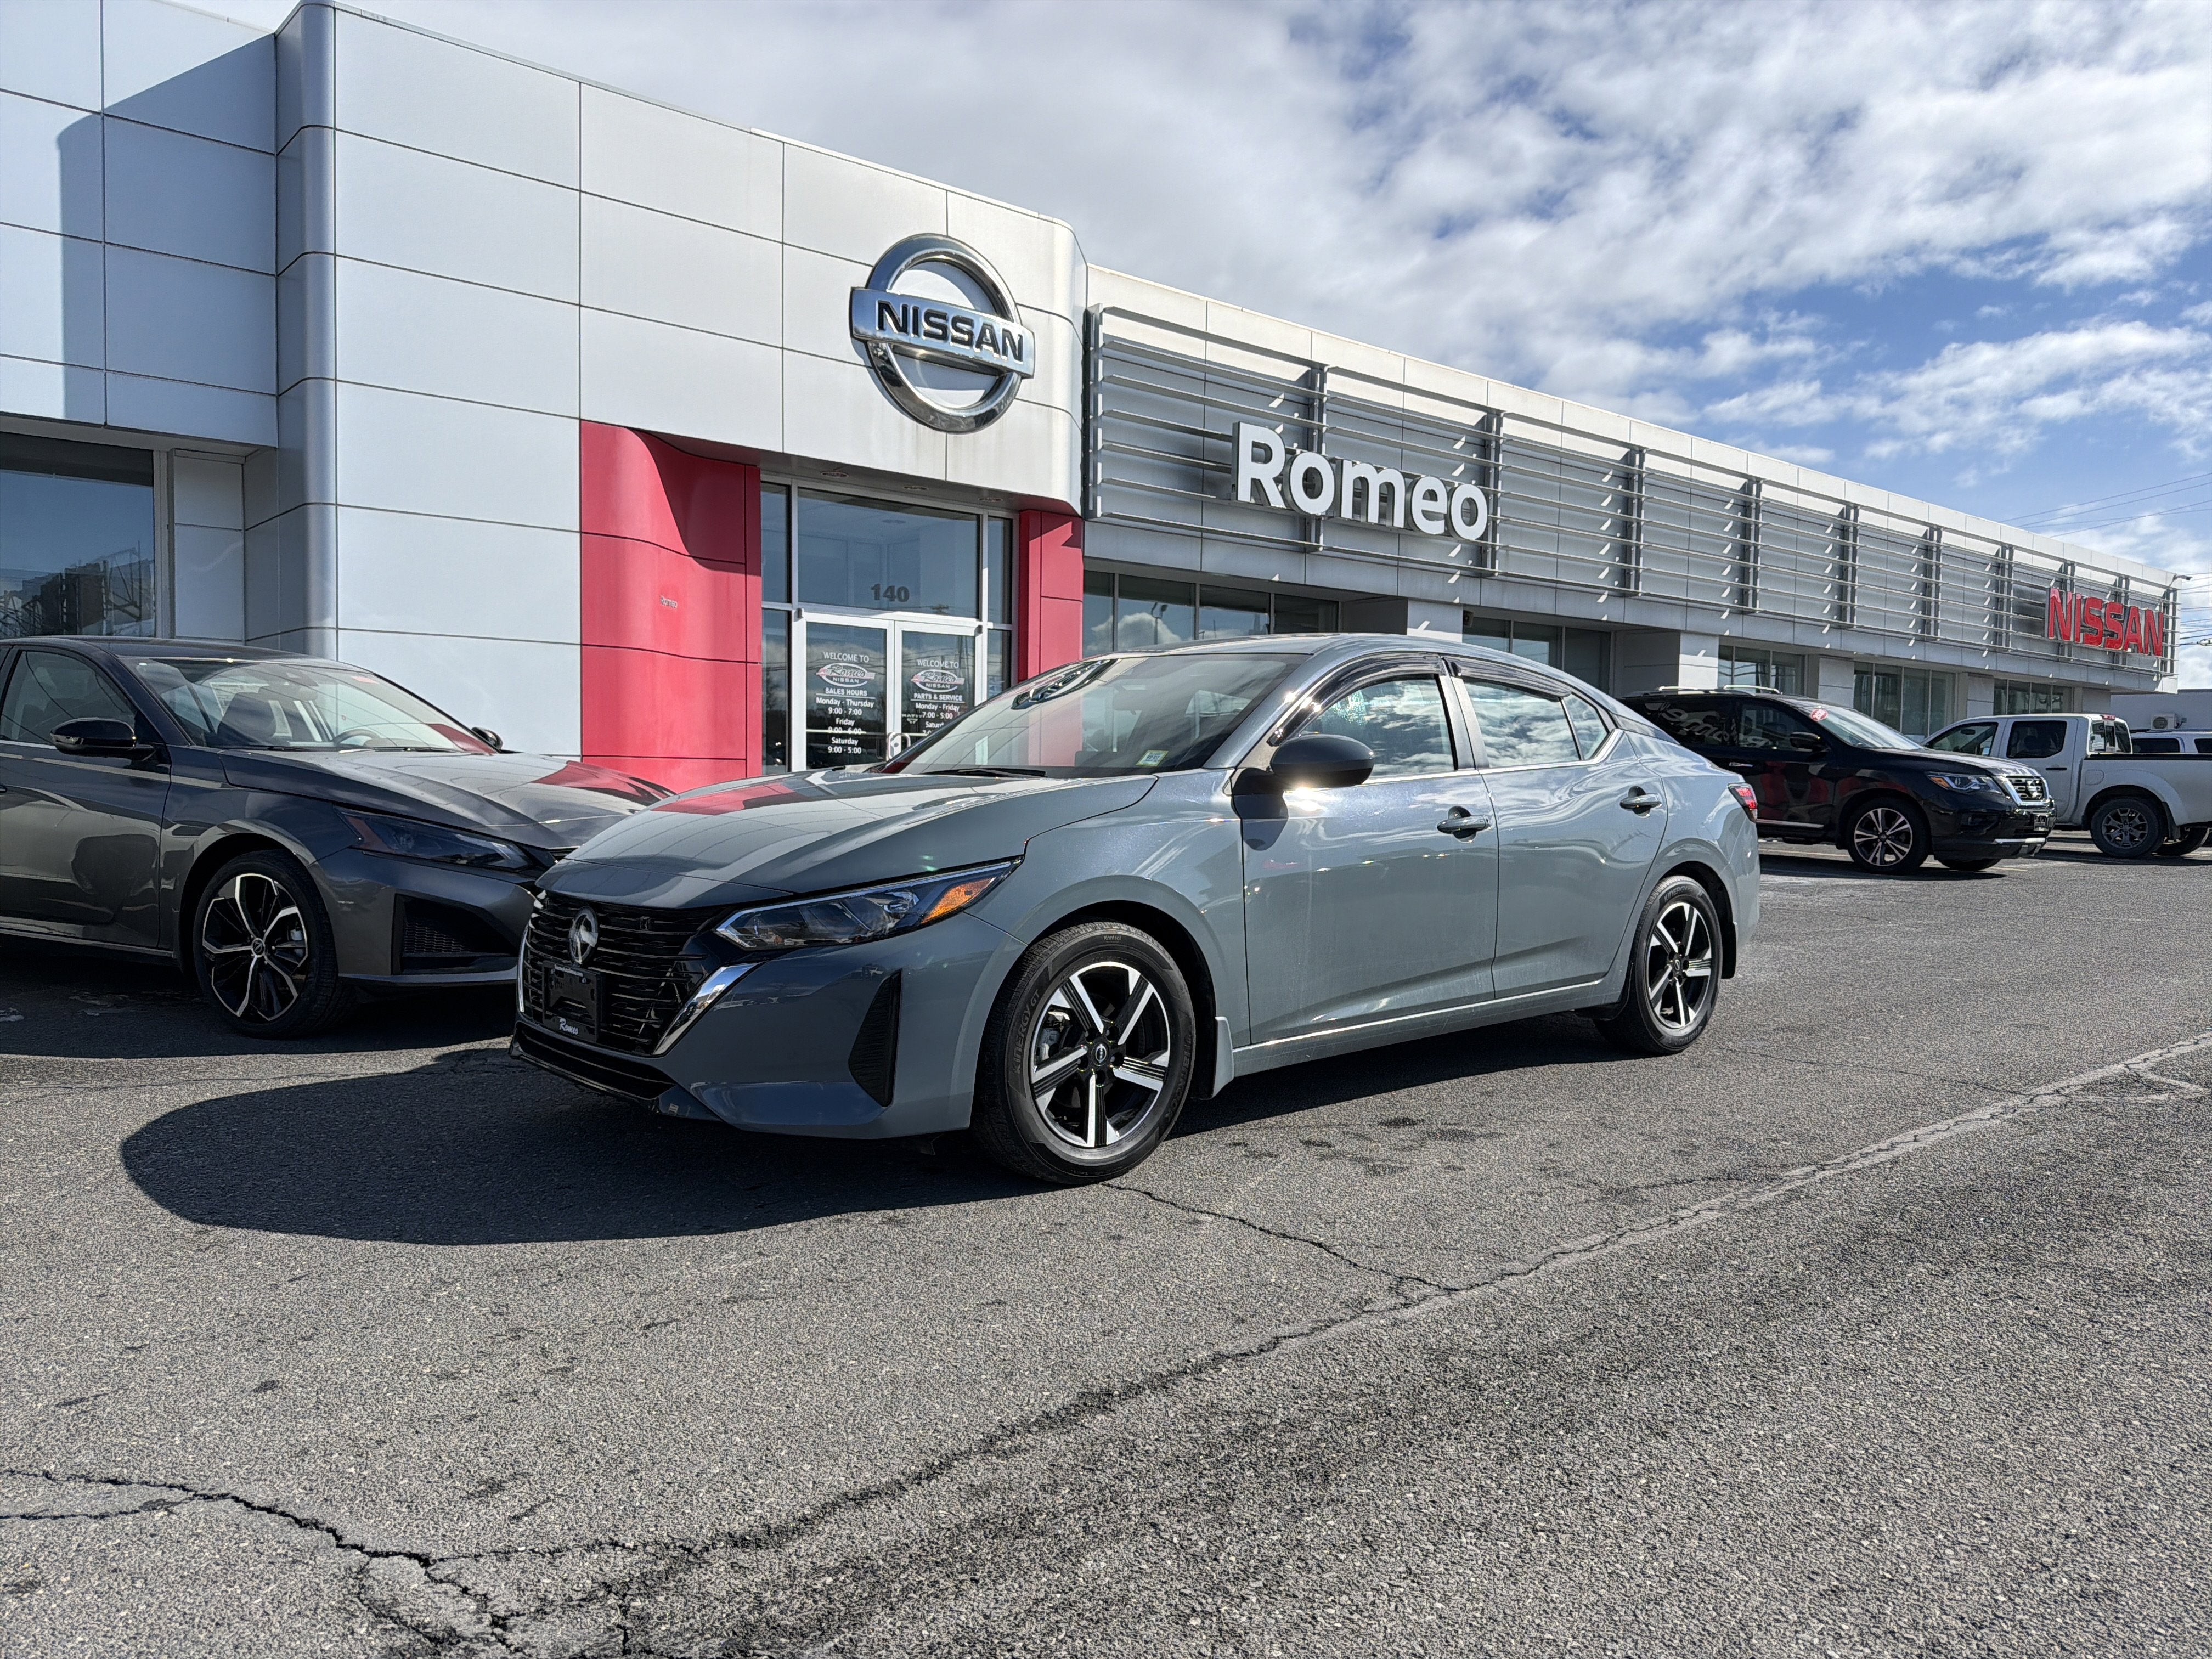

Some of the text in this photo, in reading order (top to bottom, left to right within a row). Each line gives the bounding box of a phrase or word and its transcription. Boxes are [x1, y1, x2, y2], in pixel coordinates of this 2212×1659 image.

[876, 301, 1024, 364] NISSAN
[1232, 421, 1487, 541] Romeo
[871, 584, 910, 602] 140
[2045, 588, 2164, 657] NISSAN
[823, 652, 870, 663] WELCOME TO
[917, 659, 949, 668] WELCOME
[827, 664, 866, 677] Romeo
[921, 670, 956, 683] Romeo
[816, 697, 841, 706] Monday
[846, 699, 874, 708] Thursday
[915, 702, 938, 710] Monday
[836, 718, 855, 726] Friday
[832, 737, 859, 746] Saturday
[1030, 989, 1040, 1007] GT
